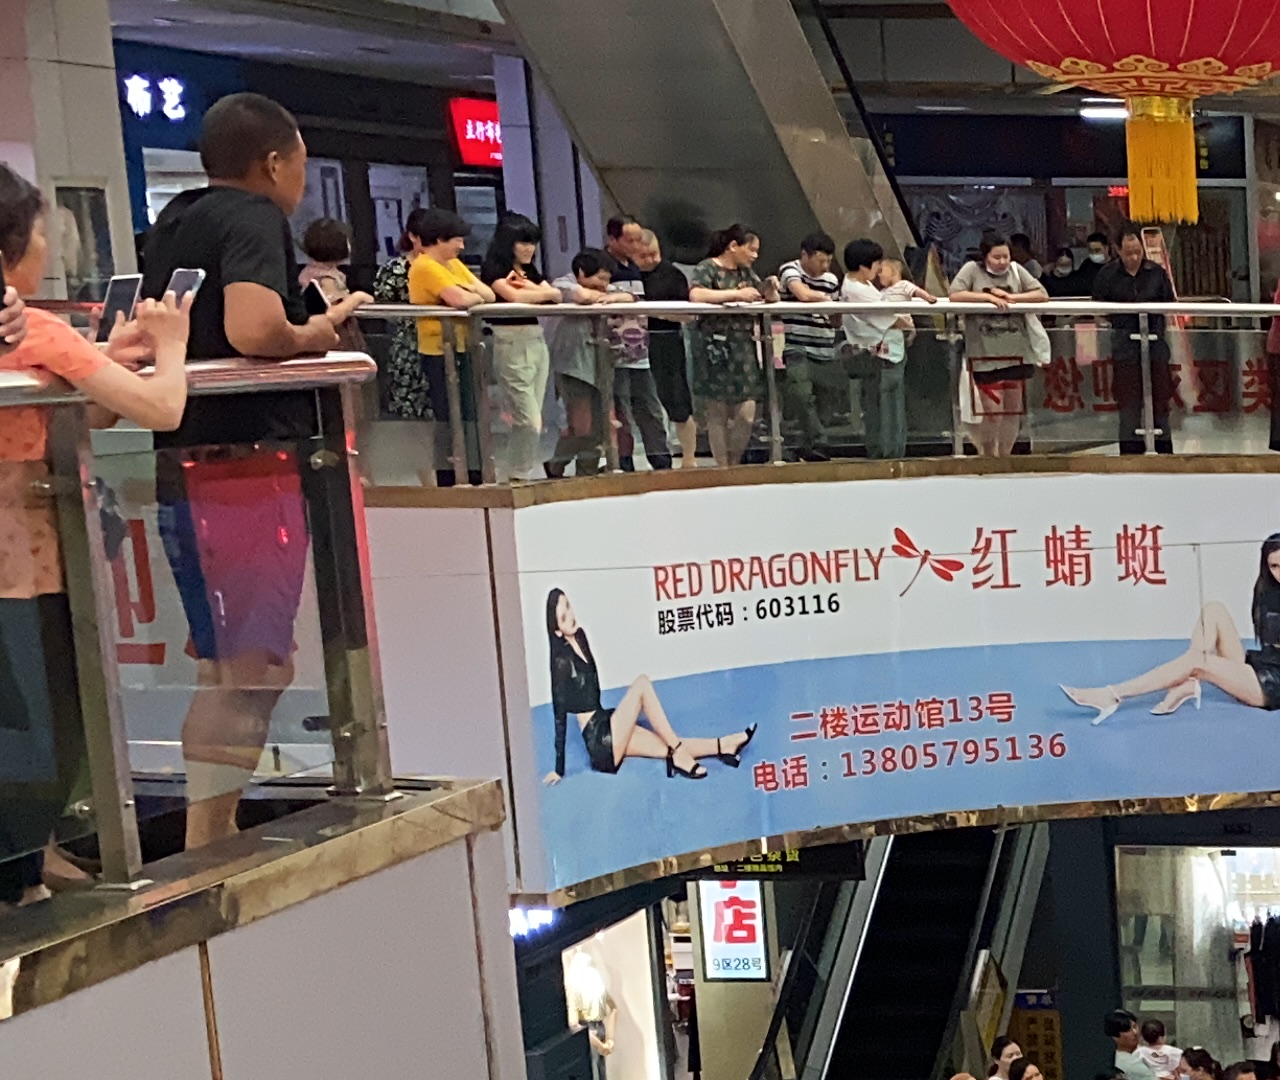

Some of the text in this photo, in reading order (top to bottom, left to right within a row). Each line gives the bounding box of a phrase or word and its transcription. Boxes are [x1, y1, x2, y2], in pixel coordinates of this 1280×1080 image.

[653, 547, 885, 602] RED DRAGONFLY
[970, 523, 1167, 590] 红蜻蜓
[657, 592, 841, 635] 股票代码：603116
[790, 692, 1017, 742] 二楼运动馆13号
[752, 732, 1068, 792] 电话：13805795136
[713, 880, 757, 945] 店
[712, 957, 762, 972] 9区28号
